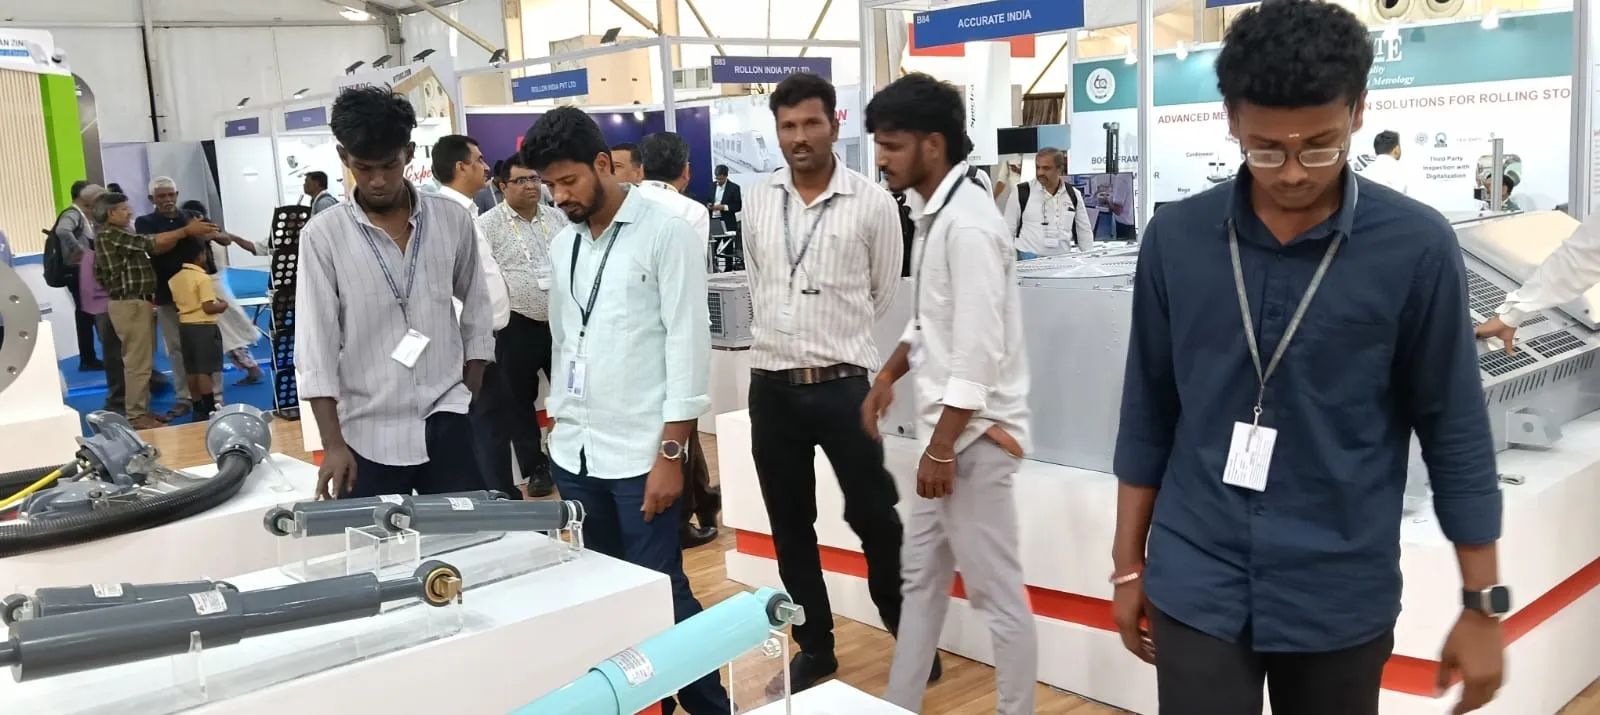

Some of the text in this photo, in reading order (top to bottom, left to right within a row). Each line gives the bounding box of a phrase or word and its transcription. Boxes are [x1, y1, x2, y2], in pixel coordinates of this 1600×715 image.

[916, 15, 930, 24] B84
[958, 9, 1032, 28] ACCURATE INDIA
[734, 66, 763, 74] ROLLON
[764, 66, 783, 74] INDIA
[783, 66, 796, 74] PVT
[1373, 75, 1415, 86] Metrology
[1157, 112, 1210, 124] ADVANCED
[1375, 96, 1446, 111] SOLUTIONS
[1449, 94, 1475, 105] FOR
[1479, 90, 1539, 103] ROLLING
[1543, 88, 1571, 100] STO
[1422, 164, 1456, 172] Inspection
[1425, 172, 1467, 180] Digitalization
